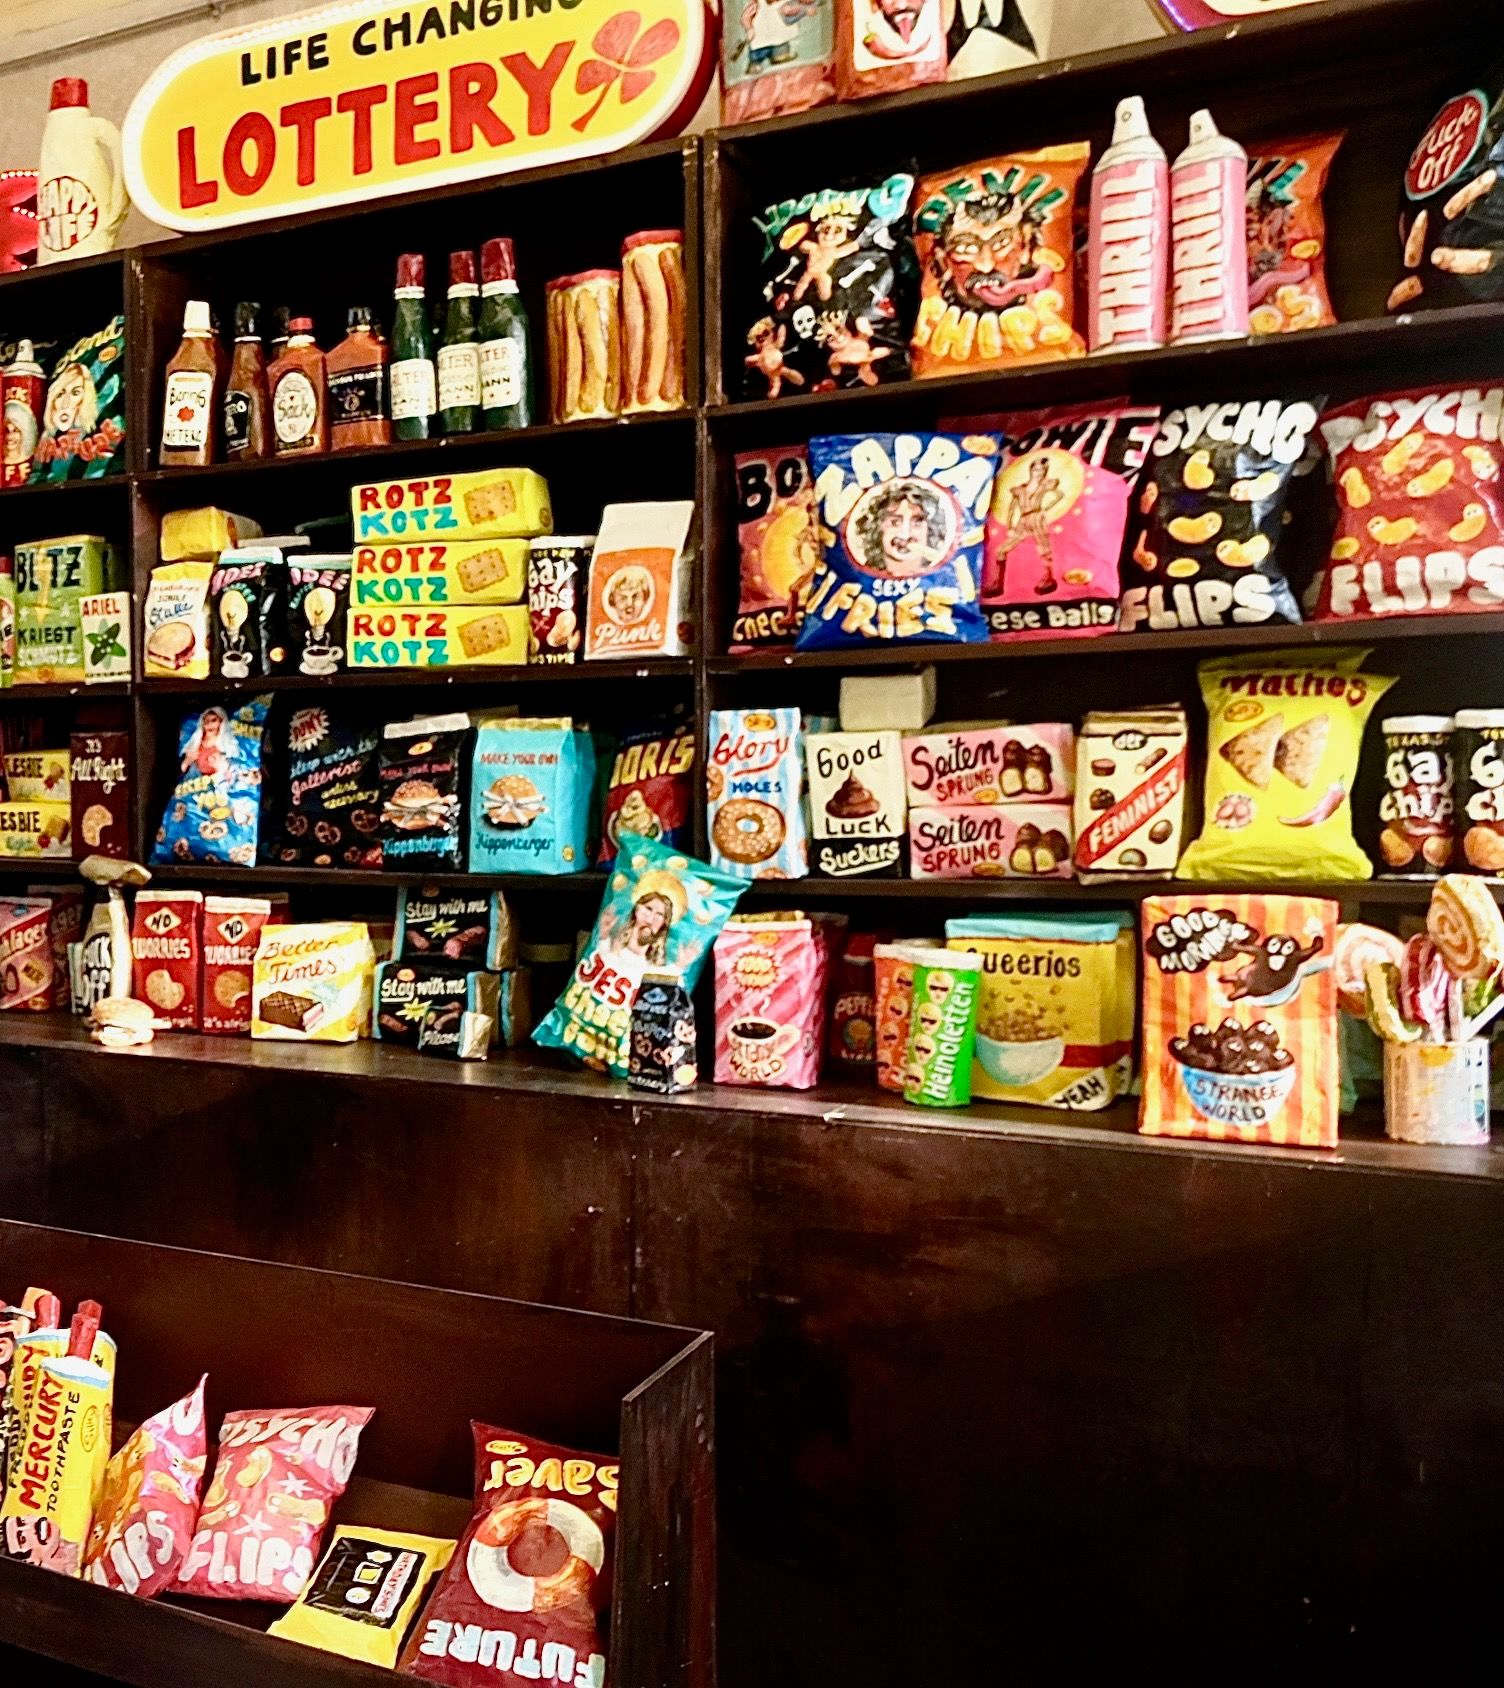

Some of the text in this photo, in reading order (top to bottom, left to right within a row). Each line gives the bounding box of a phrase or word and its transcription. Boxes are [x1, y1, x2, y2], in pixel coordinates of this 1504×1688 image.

[241, 33, 328, 87] LIFE
[177, 40, 577, 209] LOTTERY
[1409, 102, 1479, 170] Fuck
[917, 165, 1071, 233] DEVIL
[1097, 159, 1156, 349] THRILL
[1170, 162, 1223, 340] THRILL
[911, 291, 1077, 362] CHIPS
[1152, 399, 1319, 465] SYCHO
[359, 478, 453, 512] ROTZ
[814, 434, 993, 527] ZAPPA
[359, 506, 458, 538] KOTZ
[356, 546, 448, 575] ROTZ
[290, 568, 350, 591] IDEE
[356, 576, 449, 605] KOTZ
[872, 577, 920, 597] SEXY
[1329, 546, 1504, 616] FLIPS
[82, 597, 121, 618] ARIEL
[824, 582, 959, 639] FRIES
[1047, 601, 1121, 627] Balls
[1120, 573, 1277, 633] FLIPS
[353, 613, 447, 638] ROTZ
[593, 618, 664, 648] Punk
[353, 639, 449, 666] KOTZ
[711, 732, 793, 768] Glory
[817, 739, 885, 778] Good
[910, 738, 1000, 791] Seiten
[936, 768, 995, 801] SPRUNG
[824, 813, 893, 836] LUCK
[1089, 766, 1183, 854] FEMINIST
[914, 813, 1005, 852] Seiten
[818, 839, 900, 871] Suckers
[922, 842, 1001, 872] SPRUNG
[404, 898, 489, 922] Stay with me
[1155, 909, 1219, 948] GOOD
[132, 936, 192, 960] WORRIES
[260, 936, 341, 963] Better
[965, 945, 1082, 980] ueerios
[269, 958, 338, 986] Times
[380, 976, 468, 1000] Stay with me
[577, 953, 640, 1007] JES
[922, 981, 974, 1100] Heinoletten
[1058, 1076, 1107, 1110] YEAH
[1201, 1103, 1266, 1123] WORLD
[18, 1370, 64, 1510] MERCURY
[46, 1391, 81, 1513] TOOTHPASTE
[218, 1416, 360, 1486] PSYCHO
[178, 1529, 315, 1592] FLIPS
[419, 1617, 606, 1688] FUTURE
